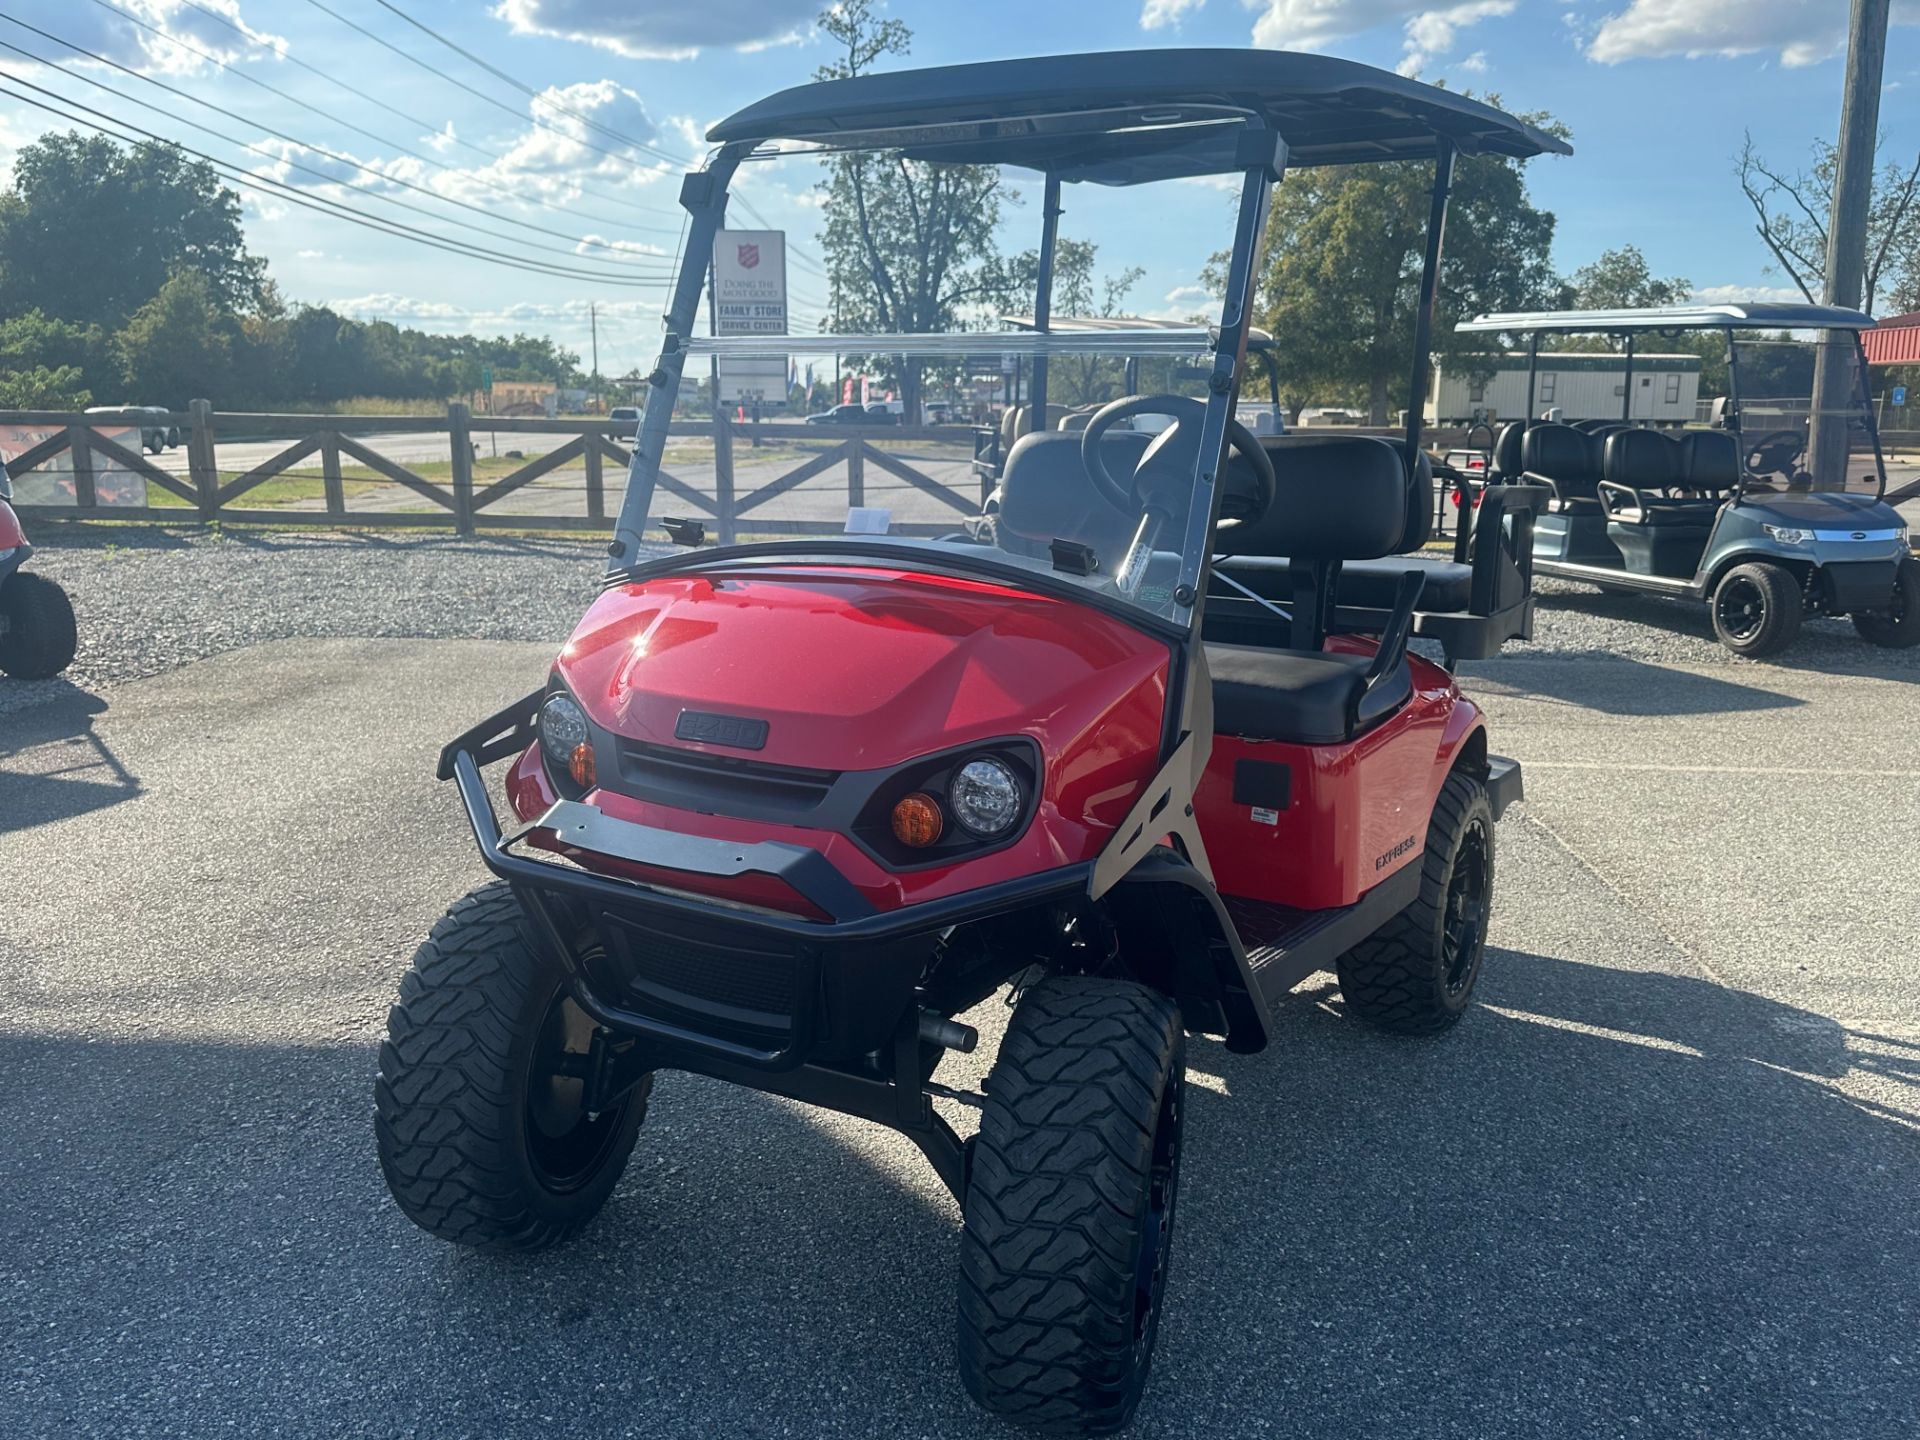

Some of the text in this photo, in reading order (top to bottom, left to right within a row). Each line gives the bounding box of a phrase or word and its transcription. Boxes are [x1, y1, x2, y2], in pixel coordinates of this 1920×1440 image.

[749, 289, 778, 298] GOOD
[719, 305, 782, 317] FAMILY STORE
[721, 321, 782, 331] SERVICE CENTER
[1375, 835, 1416, 871] EXPRESS
